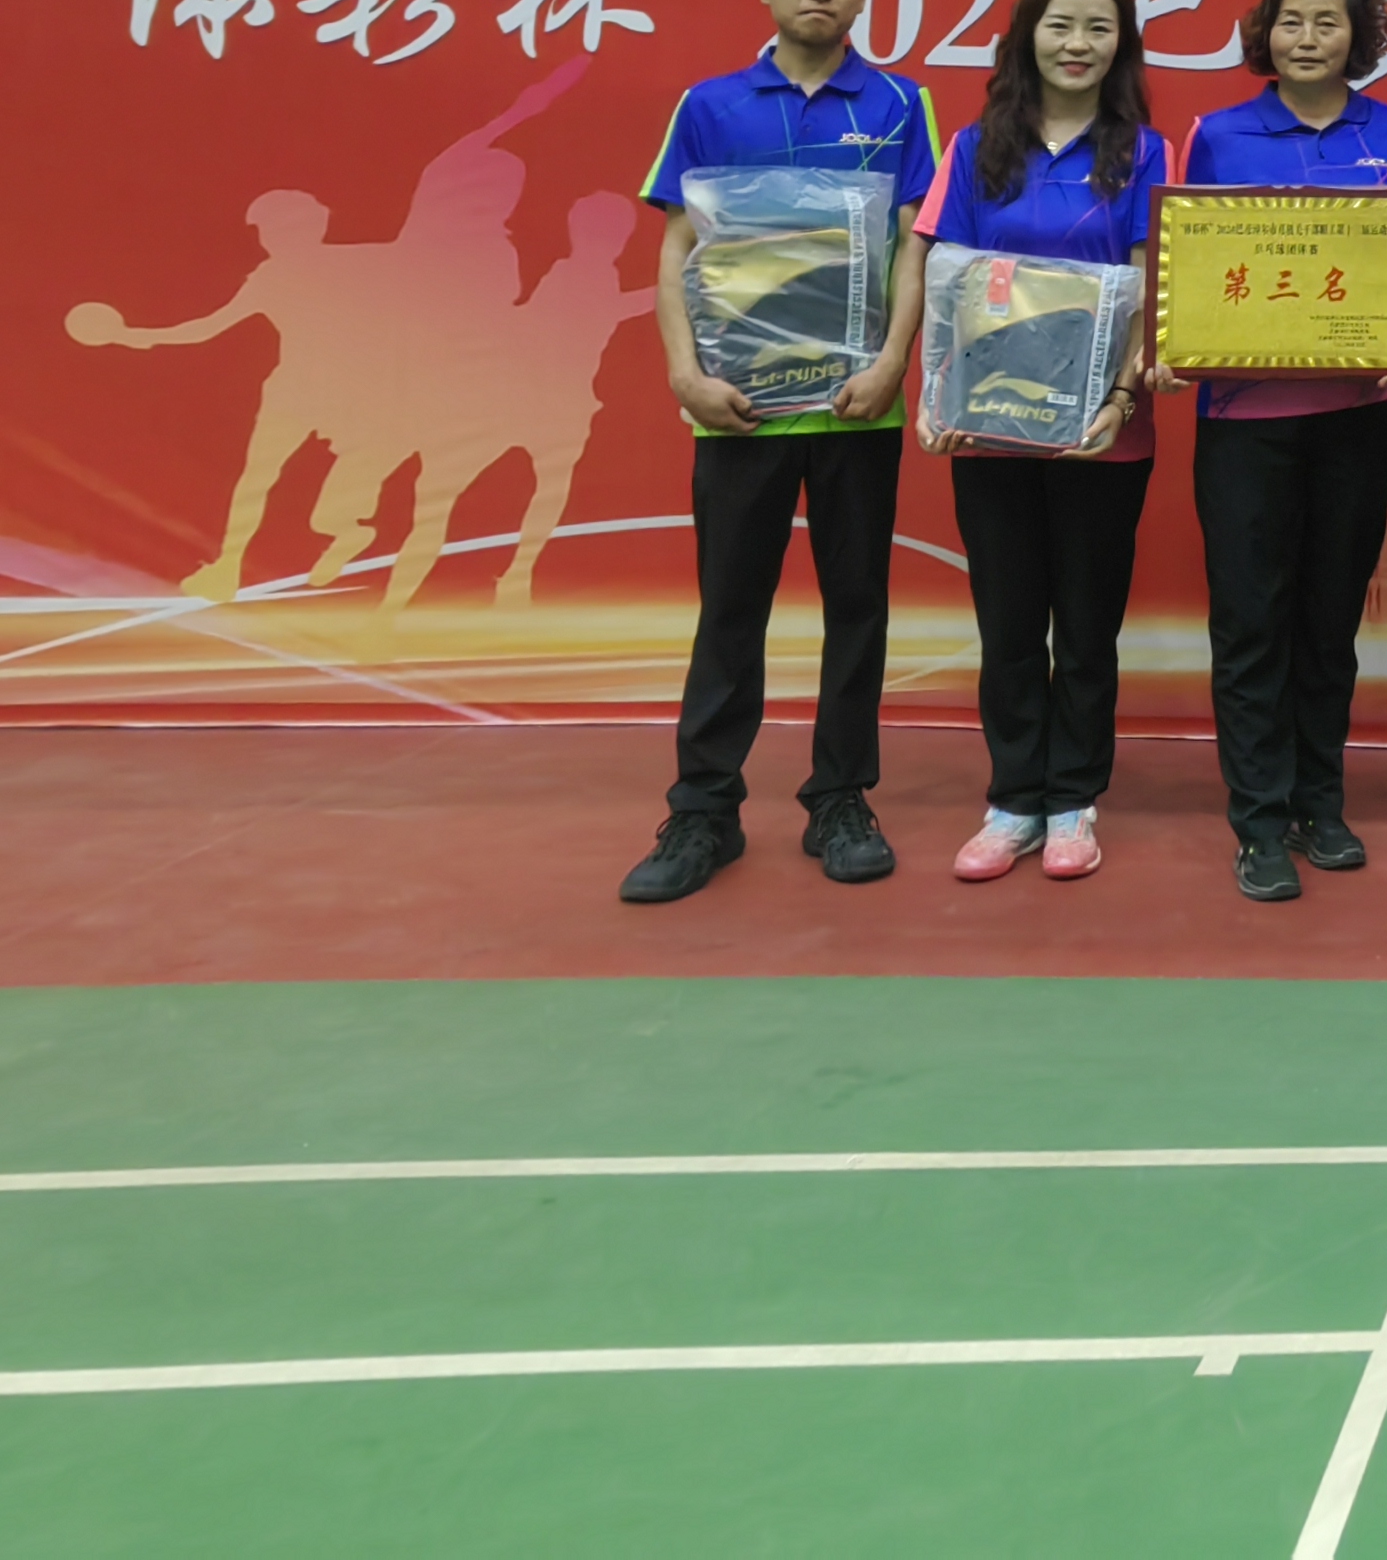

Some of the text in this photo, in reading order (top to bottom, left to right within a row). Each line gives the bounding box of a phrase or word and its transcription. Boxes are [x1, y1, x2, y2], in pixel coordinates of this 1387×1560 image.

[1222, 262, 1348, 306] 第三名
[751, 361, 846, 386] LI-NING
[967, 399, 1058, 423] LI-NING
